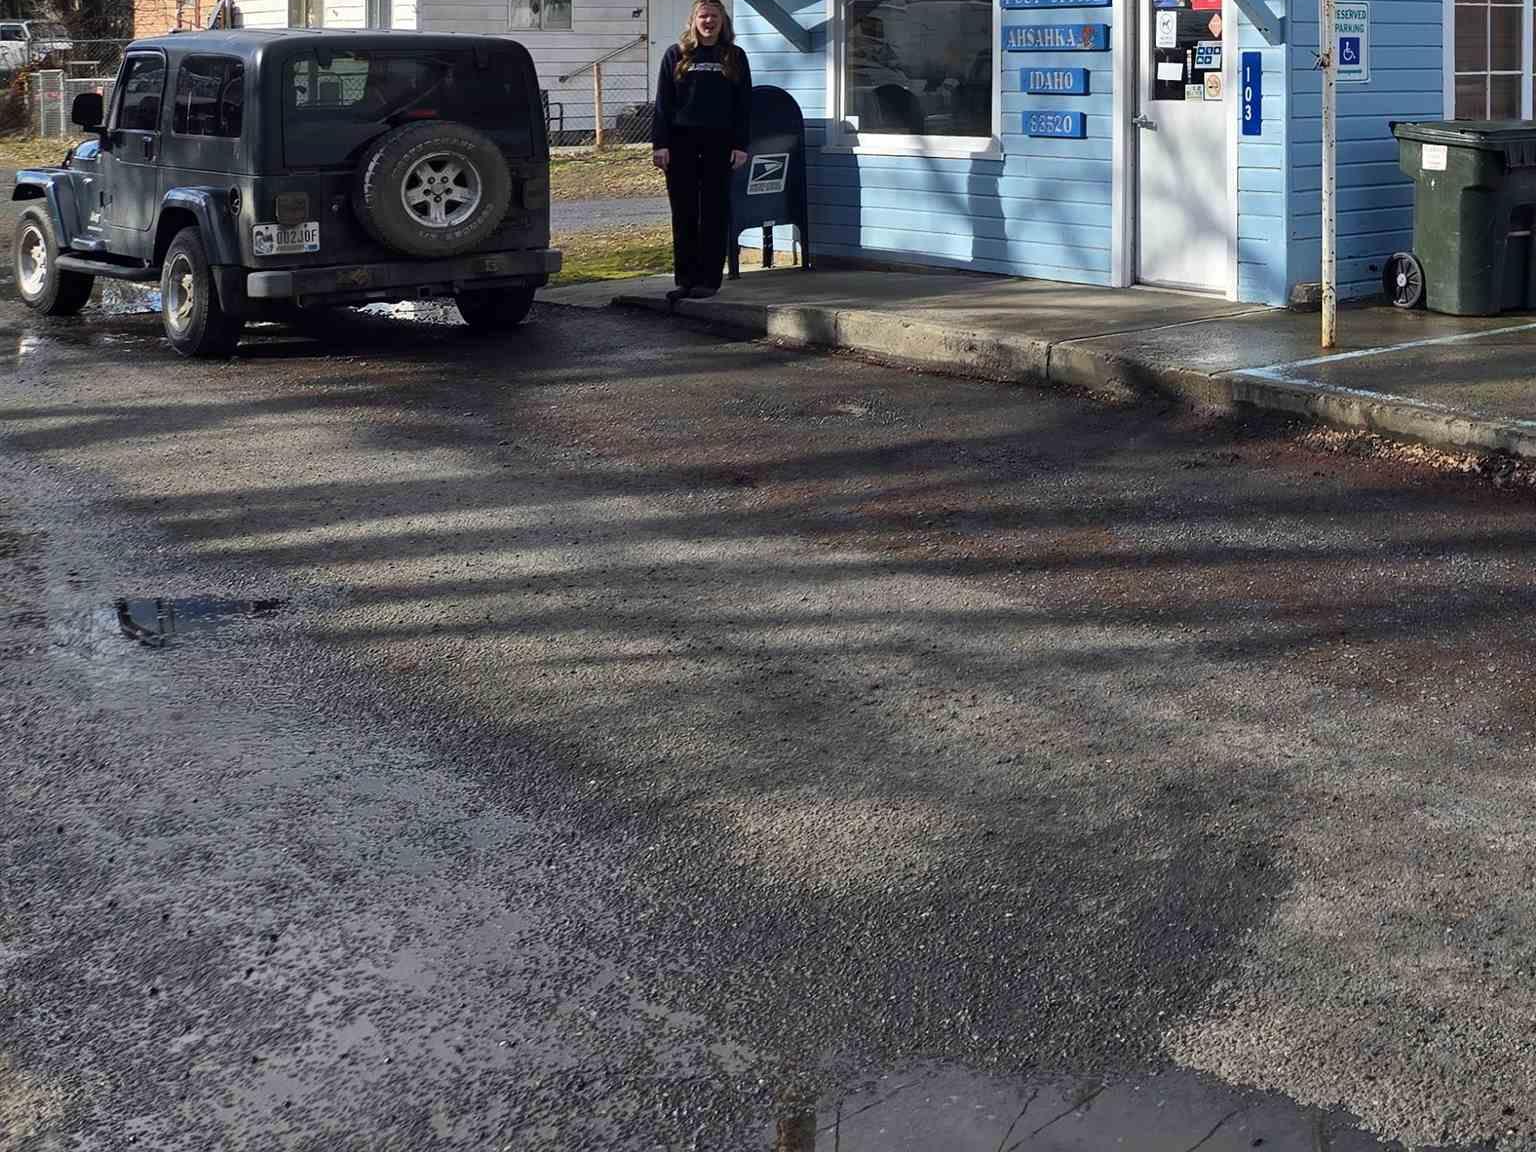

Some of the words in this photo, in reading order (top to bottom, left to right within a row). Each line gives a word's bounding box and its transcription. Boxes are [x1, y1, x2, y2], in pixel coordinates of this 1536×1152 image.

[1335, 10, 1366, 19] ESERVED
[1335, 24, 1364, 32] PARKING
[1007, 28, 1075, 47] AHSAHKA
[1030, 71, 1073, 90] IDAHO
[1030, 115, 1072, 133] 83520
